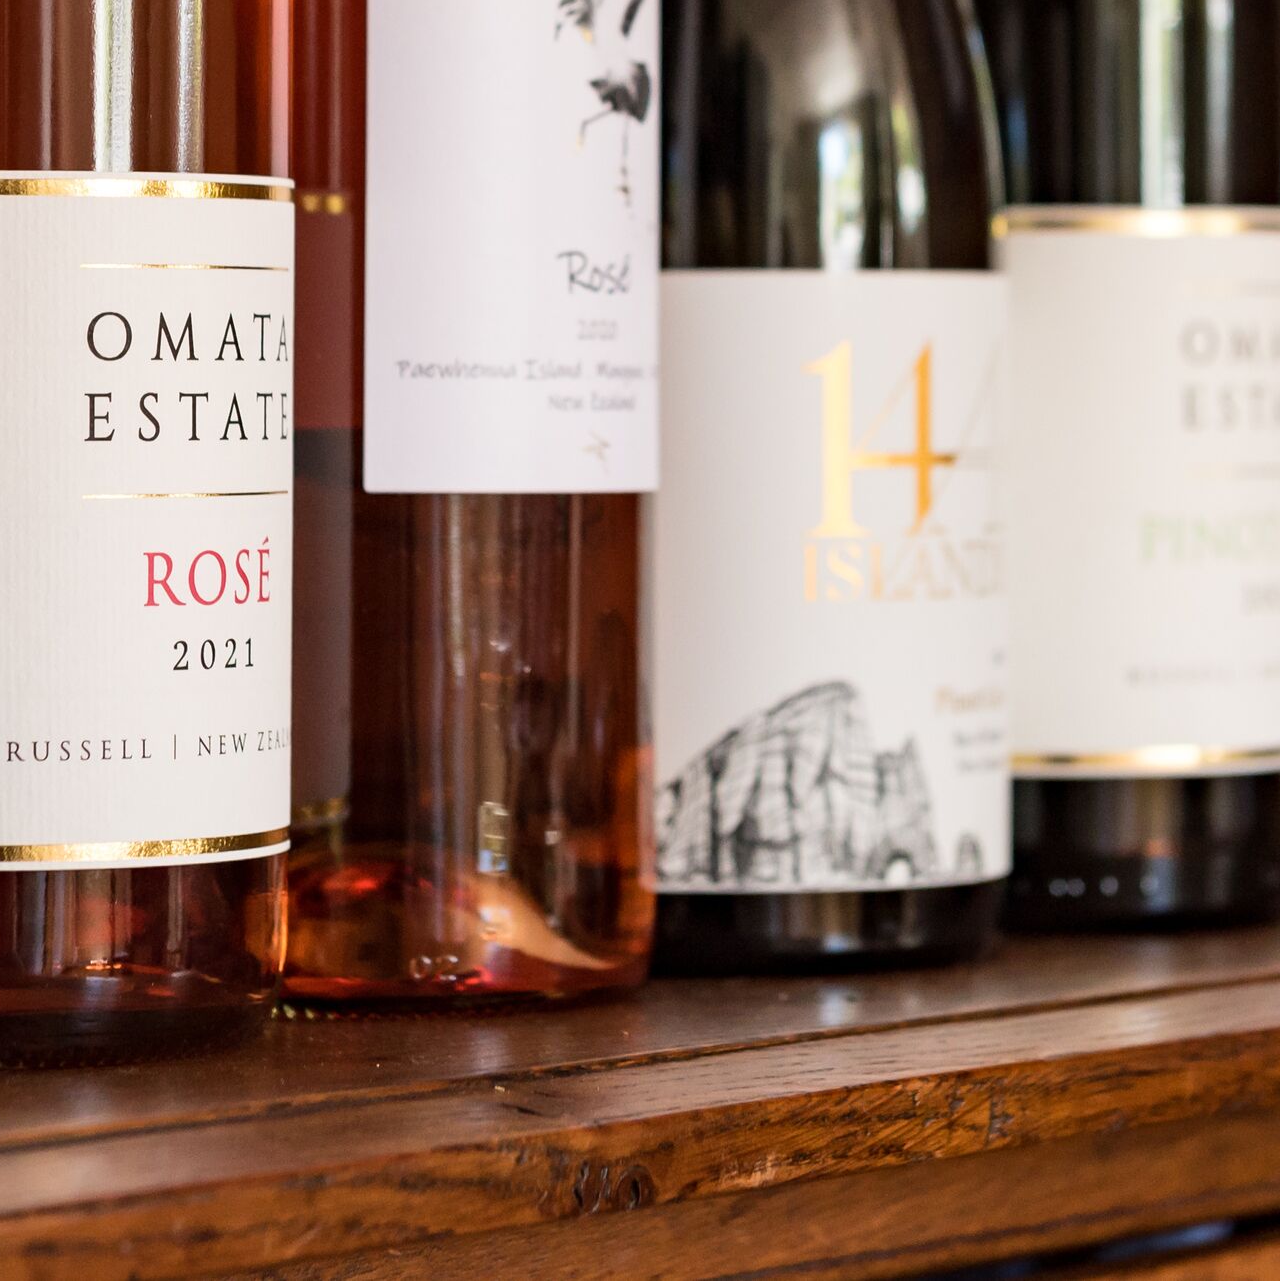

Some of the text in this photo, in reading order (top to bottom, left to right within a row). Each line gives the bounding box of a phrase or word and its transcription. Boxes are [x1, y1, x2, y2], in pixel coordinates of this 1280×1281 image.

[86, 311, 288, 363] OMATA
[84, 392, 288, 443] ESTATE
[143, 537, 271, 608] ROSÉ
[172, 637, 255, 672] 2021
[6, 737, 153, 763] RUSSELL
[197, 732, 248, 757] NEW
